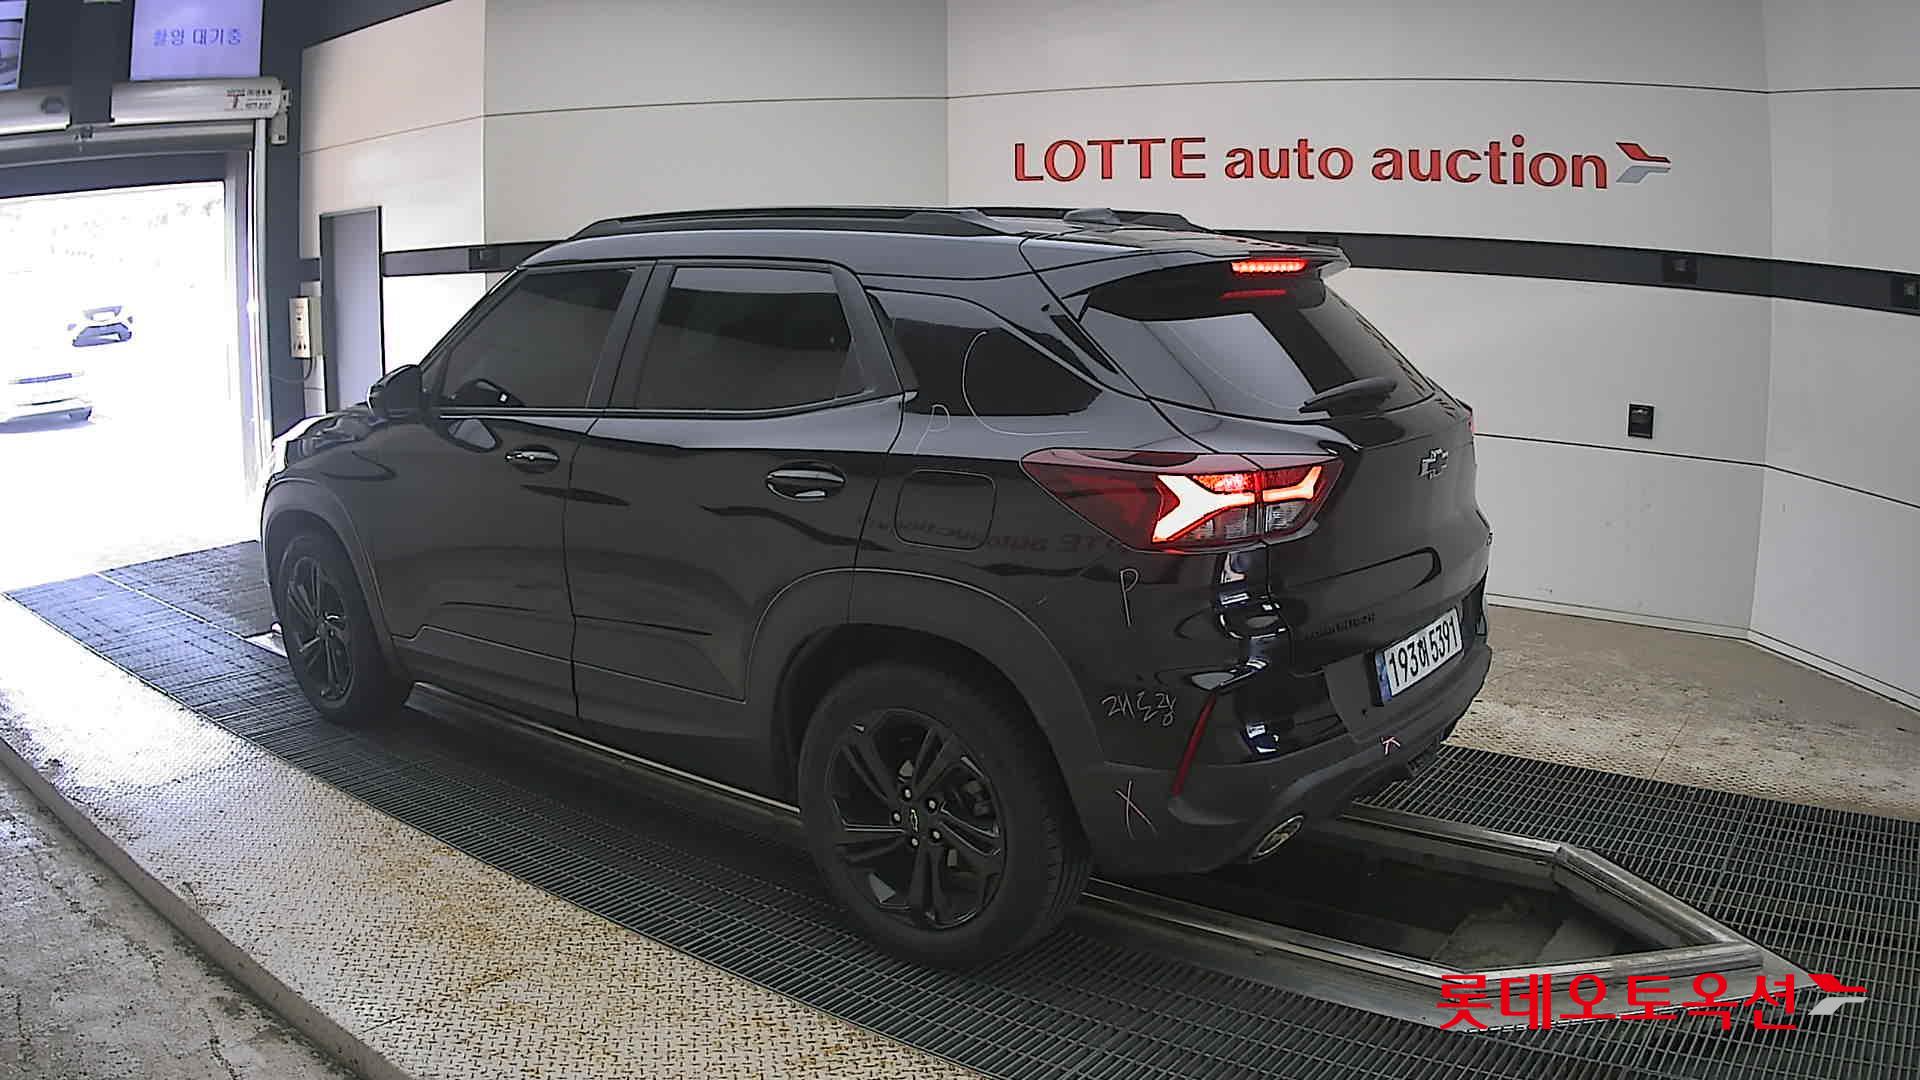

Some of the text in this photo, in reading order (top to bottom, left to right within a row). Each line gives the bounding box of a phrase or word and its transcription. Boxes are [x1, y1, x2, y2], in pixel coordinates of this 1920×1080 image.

[1014, 134, 1608, 189] LOTTE auto auction
[1119, 568, 1139, 627] P
